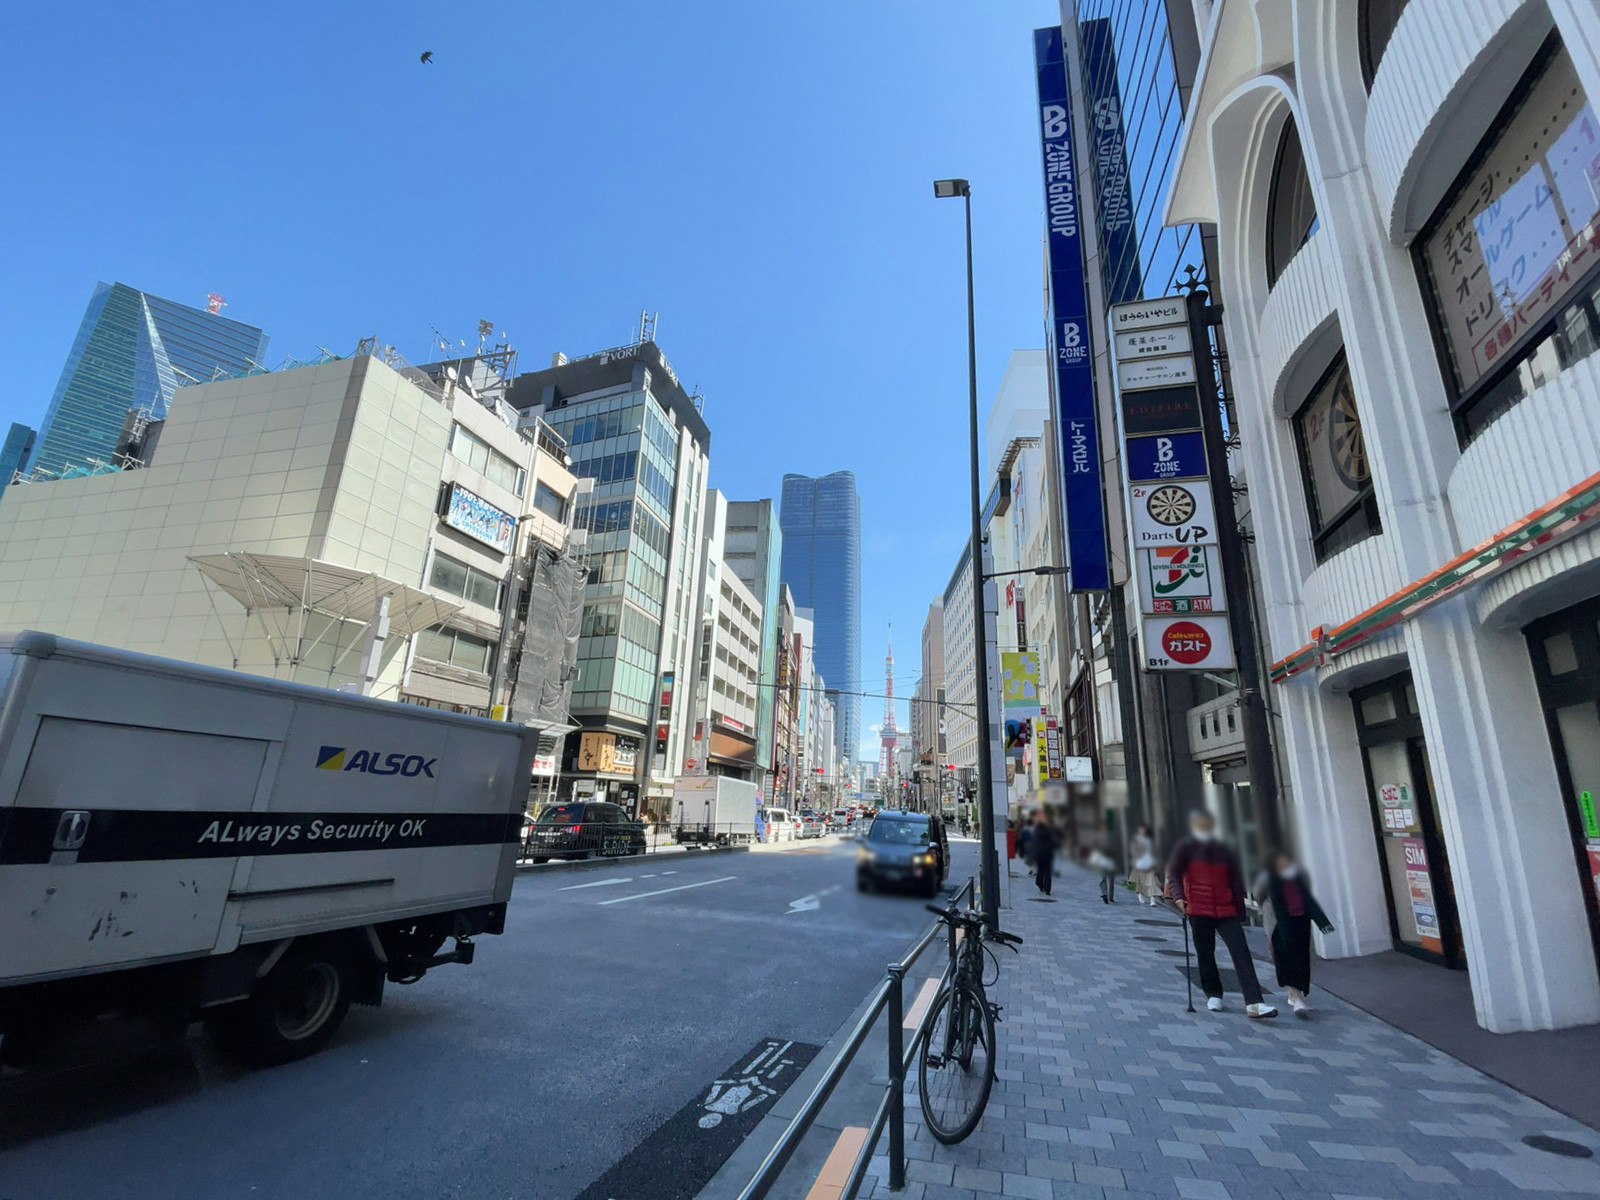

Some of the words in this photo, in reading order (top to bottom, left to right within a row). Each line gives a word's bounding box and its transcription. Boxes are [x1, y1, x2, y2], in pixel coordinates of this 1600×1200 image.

[1455, 183, 1554, 305] オールゲーム
[1119, 306, 1178, 322] ほうらいやビル
[1059, 346, 1088, 359] ZONE
[1152, 460, 1181, 473] ZONE
[1133, 488, 1147, 498] 2F
[1142, 531, 1174, 542] Darts
[1175, 525, 1209, 543] UP
[1193, 599, 1212, 611] ATM
[1169, 639, 1207, 652] ガスト
[1149, 658, 1170, 666] B1F
[344, 748, 438, 779] ALSOK
[197, 819, 302, 848] ALways
[306, 818, 396, 843] Security
[399, 819, 427, 839] OK
[1405, 847, 1427, 866] SIM
